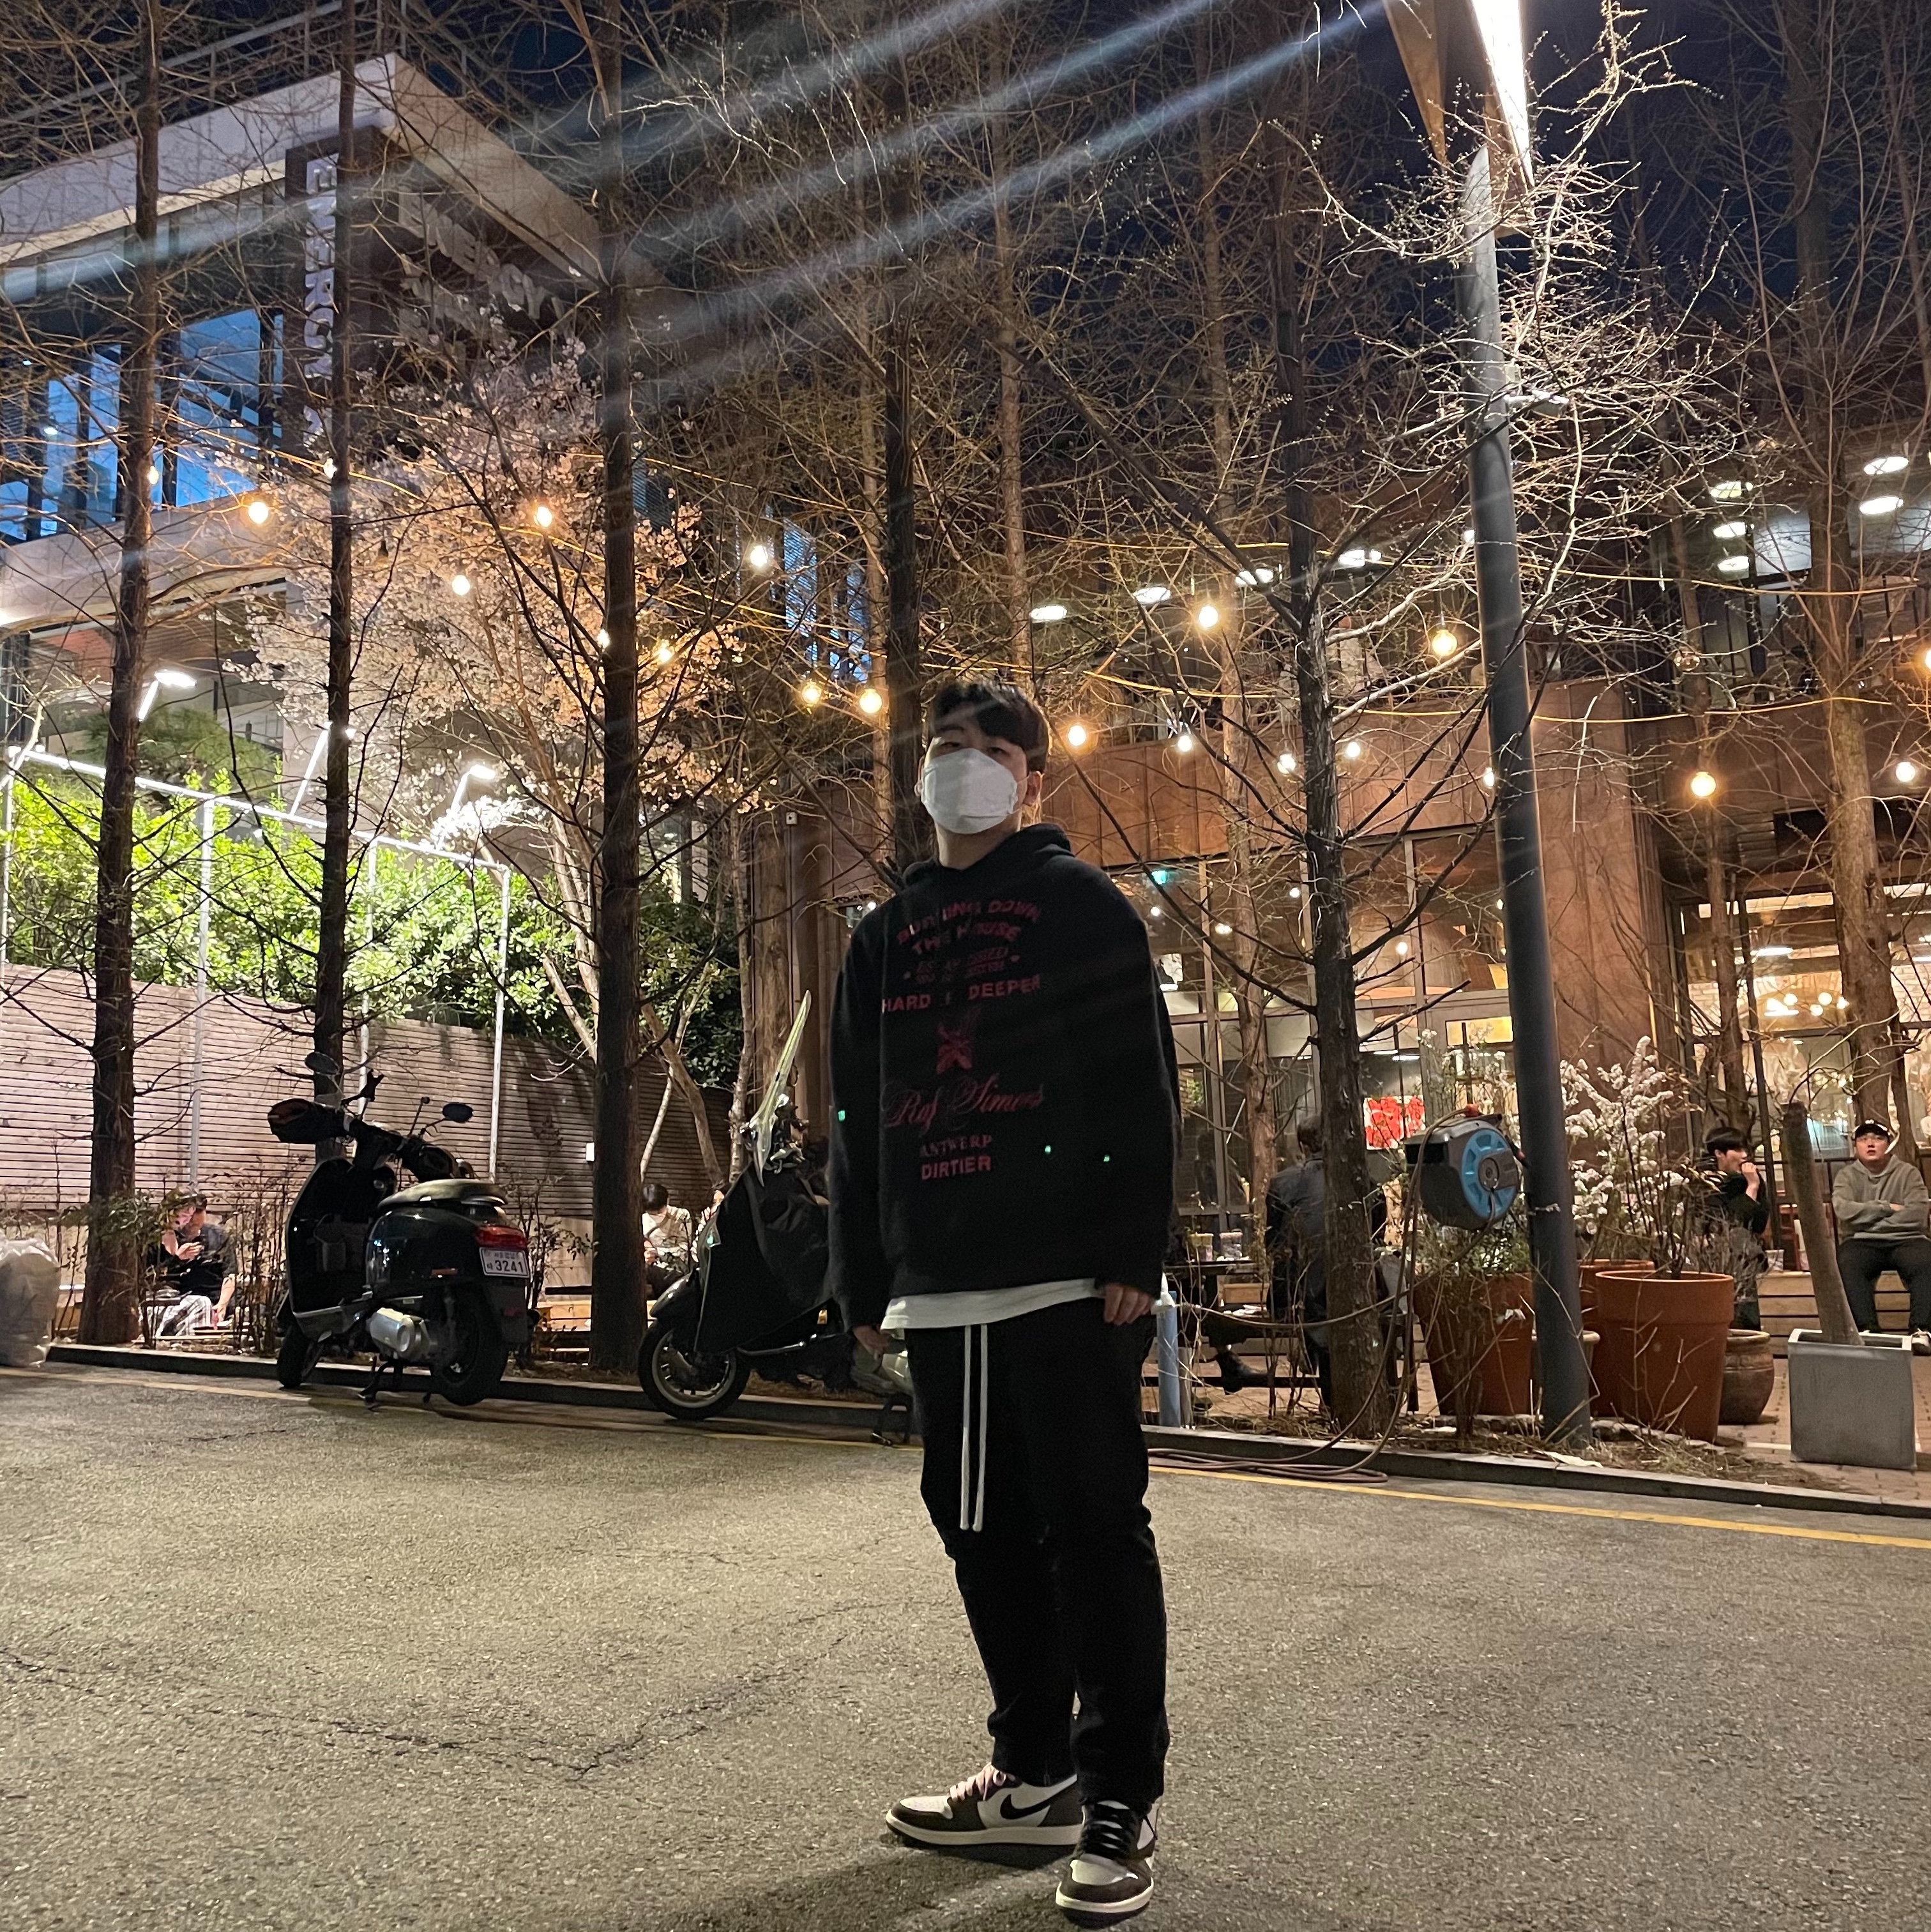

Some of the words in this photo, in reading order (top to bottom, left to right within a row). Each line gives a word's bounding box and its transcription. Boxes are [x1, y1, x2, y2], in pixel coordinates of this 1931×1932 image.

[304, 152, 338, 381] ENERGY
[988, 900, 1041, 924] DOWN
[967, 975, 1040, 1001] DEEPER
[921, 1155, 992, 1180] DIRTIER
[495, 1259, 523, 1273] 3241
